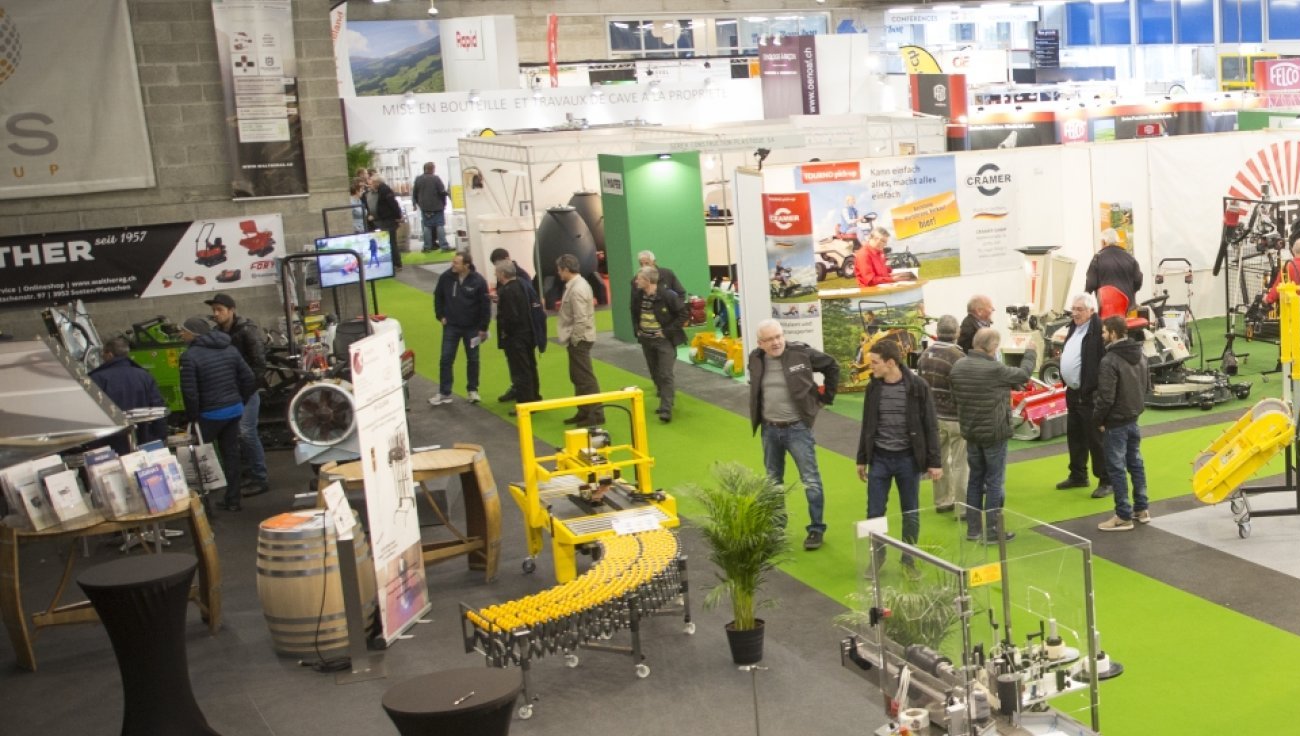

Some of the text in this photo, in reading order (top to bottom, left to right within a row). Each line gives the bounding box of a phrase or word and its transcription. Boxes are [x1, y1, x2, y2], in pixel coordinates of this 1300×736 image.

[455, 29, 478, 52] Rapid
[1270, 62, 1300, 87] FELCO
[382, 103, 414, 116] MISE
[419, 101, 436, 114] EN
[440, 99, 508, 113] BOUTEILLE
[515, 98, 528, 109] ET
[531, 95, 587, 107] TRAVAUX
[590, 94, 605, 104] DE
[608, 92, 638, 104] CAVE
[870, 165, 921, 176] Kann einfach
[871, 176, 937, 189] alles, macht alles
[966, 174, 1011, 186] CRAMER
[871, 190, 901, 200] einfach
[768, 214, 800, 224] CRAMER
[95, 230, 147, 246] seit 1957
[23, 283, 65, 291] Onlineshop
[71, 275, 137, 287] www.waltherag.ch
